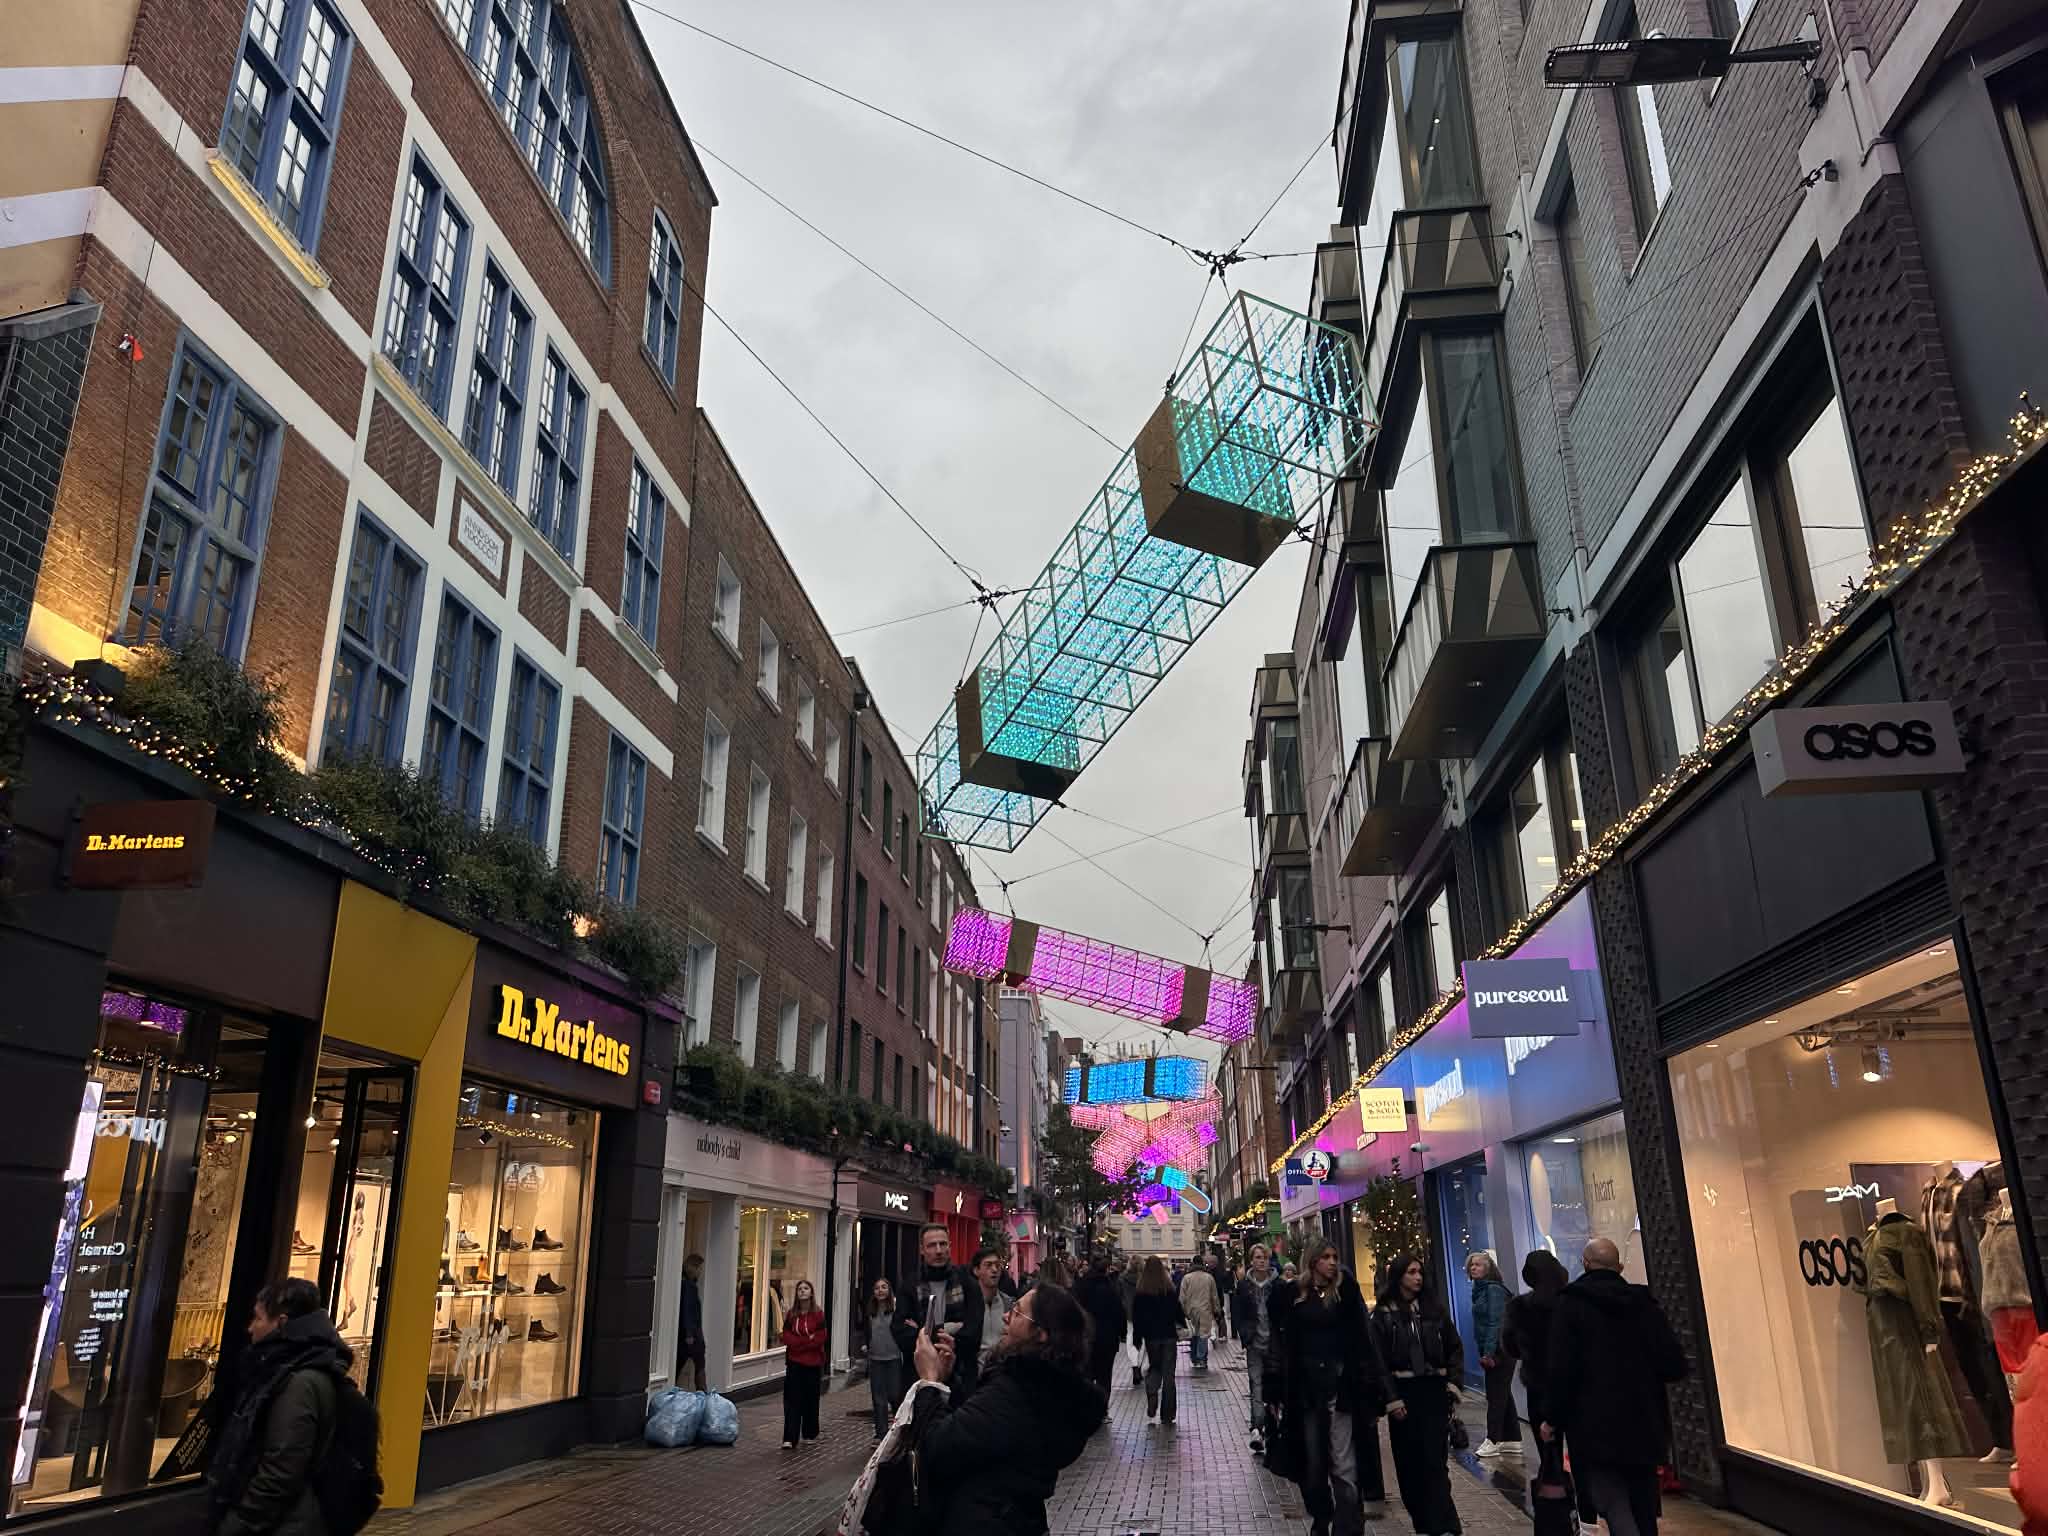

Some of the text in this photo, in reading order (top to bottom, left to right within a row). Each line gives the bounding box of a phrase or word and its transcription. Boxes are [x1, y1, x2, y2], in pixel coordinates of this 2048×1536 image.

[1804, 719, 1937, 761] asos
[1474, 985, 1569, 1008] pureseoul
[697, 1133, 742, 1162] nobody's child
[1592, 1171, 1617, 1201] heart
[885, 1191, 909, 1211] MAC
[1799, 1236, 1869, 1287] asos
